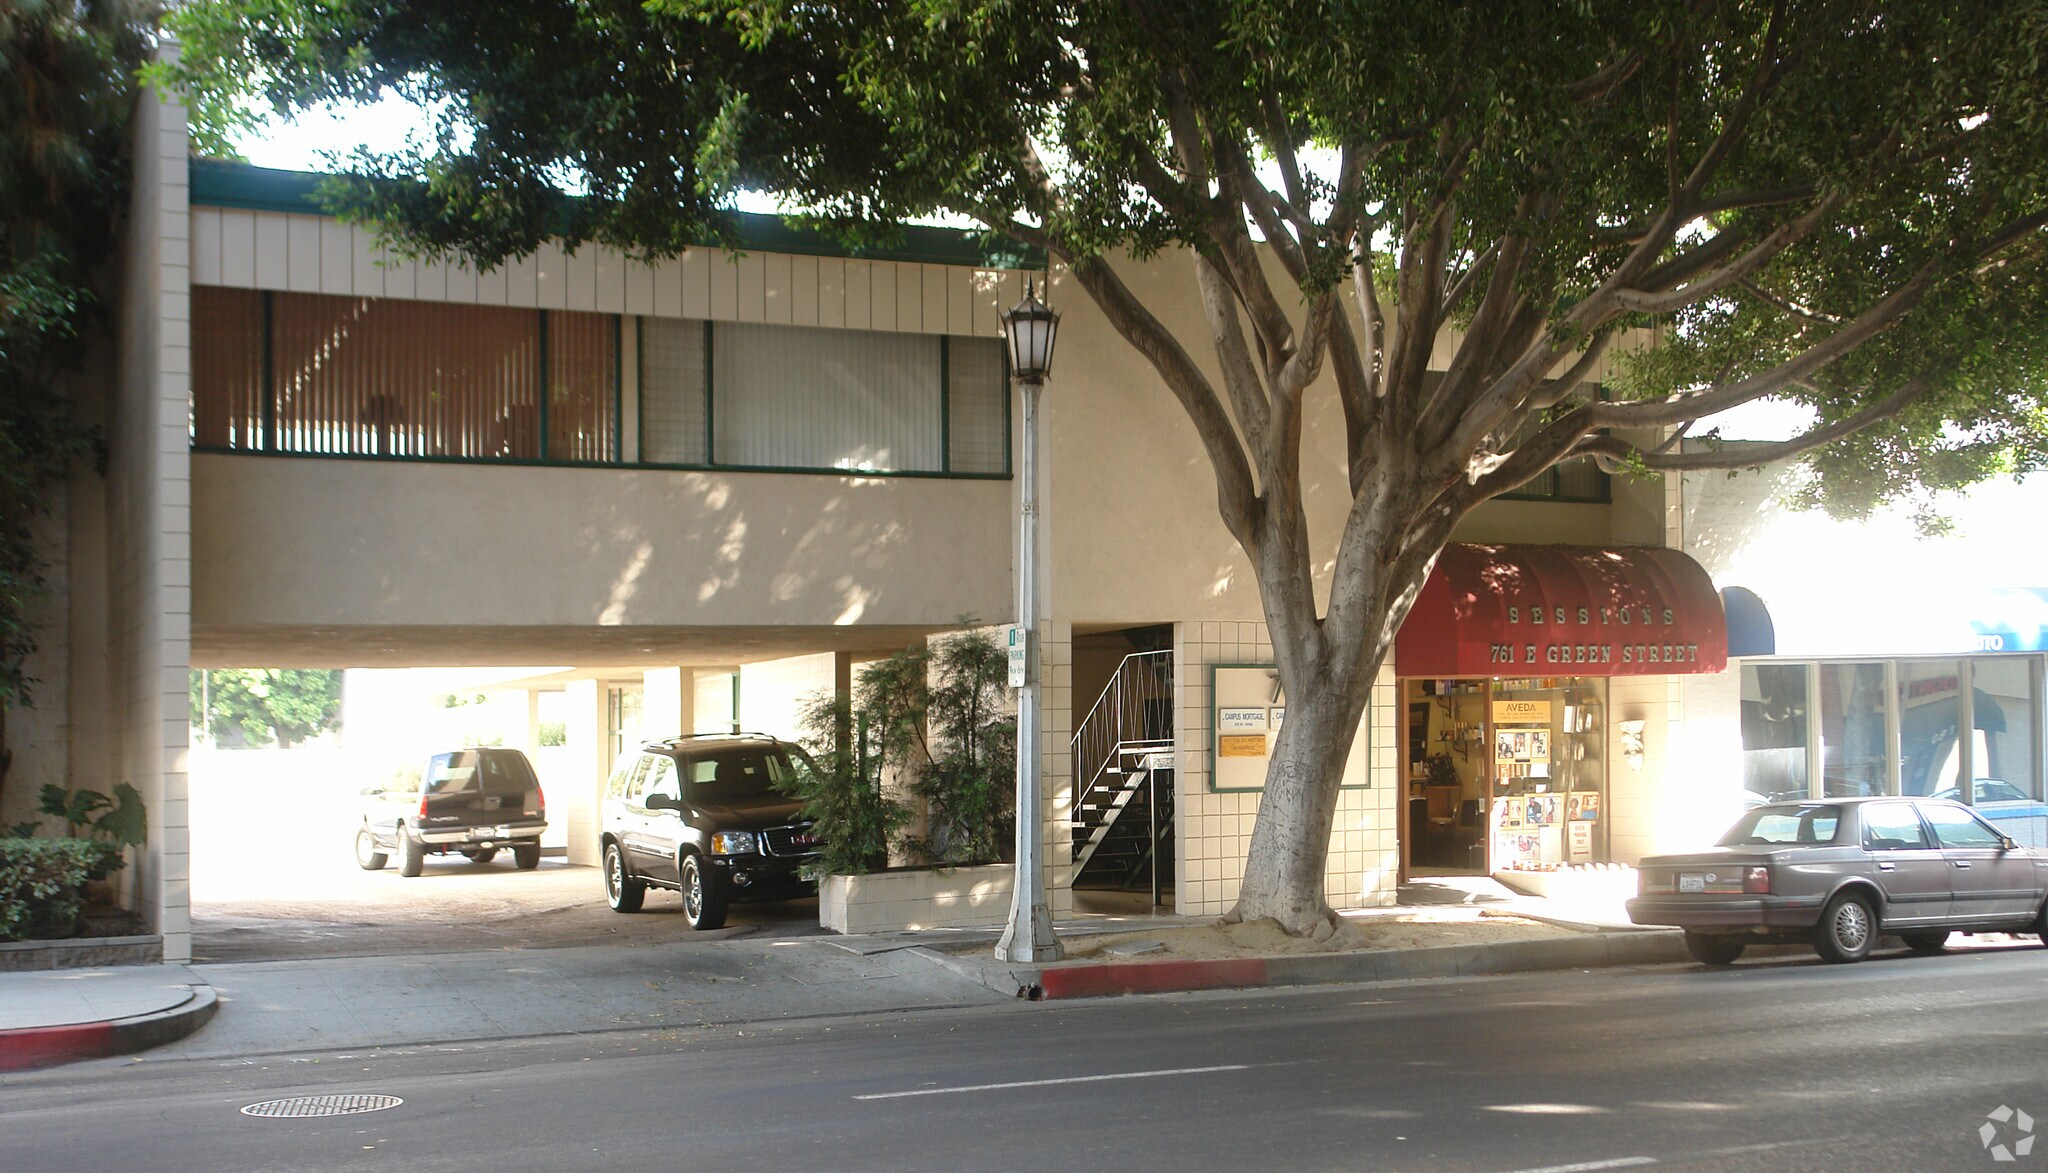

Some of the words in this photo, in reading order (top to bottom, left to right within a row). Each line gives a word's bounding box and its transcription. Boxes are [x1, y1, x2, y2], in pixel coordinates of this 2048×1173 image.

[1509, 606, 1674, 625] SESSIONS
[1491, 644, 1515, 663] 761
[1525, 644, 1537, 663] E
[1546, 644, 1611, 663] GREEN
[1622, 644, 1698, 663] STREET
[1505, 702, 1537, 712] AVEDA
